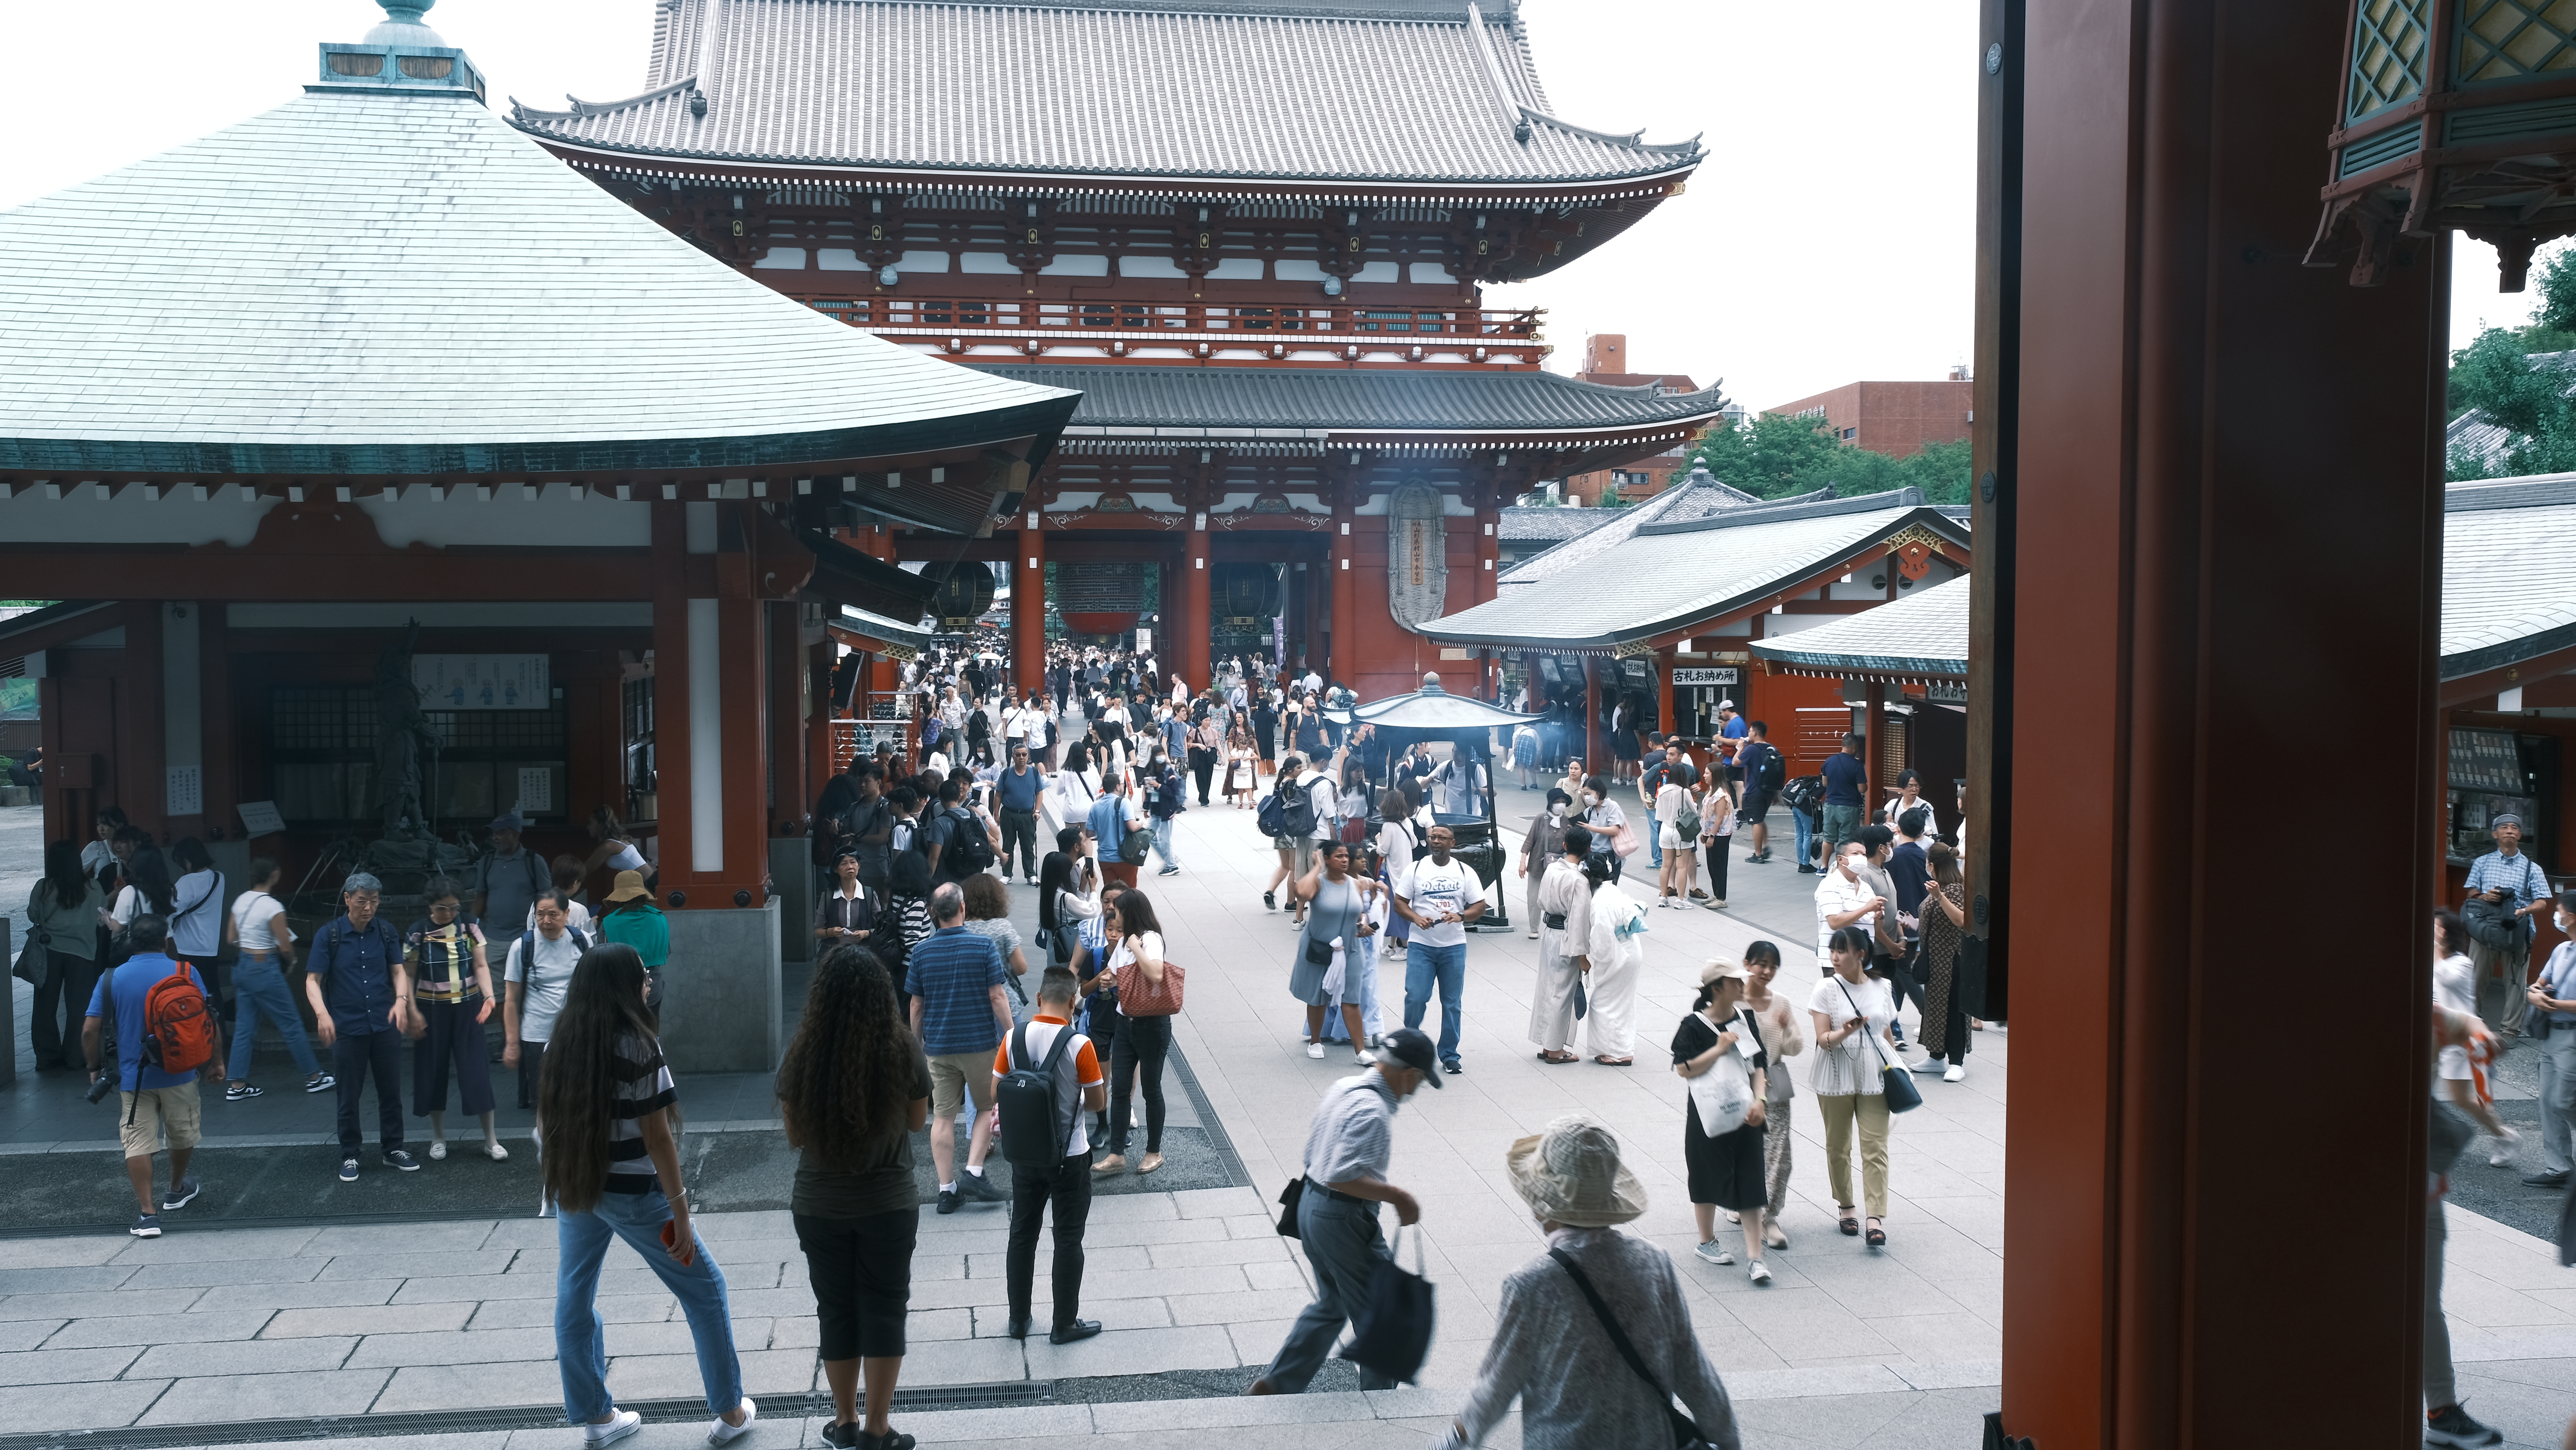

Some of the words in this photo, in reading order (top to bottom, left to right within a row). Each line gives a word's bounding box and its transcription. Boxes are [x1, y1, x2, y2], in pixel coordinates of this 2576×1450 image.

[1674, 670, 1735, 682] 古札お納め所
[1422, 881, 1461, 892] Detroit
